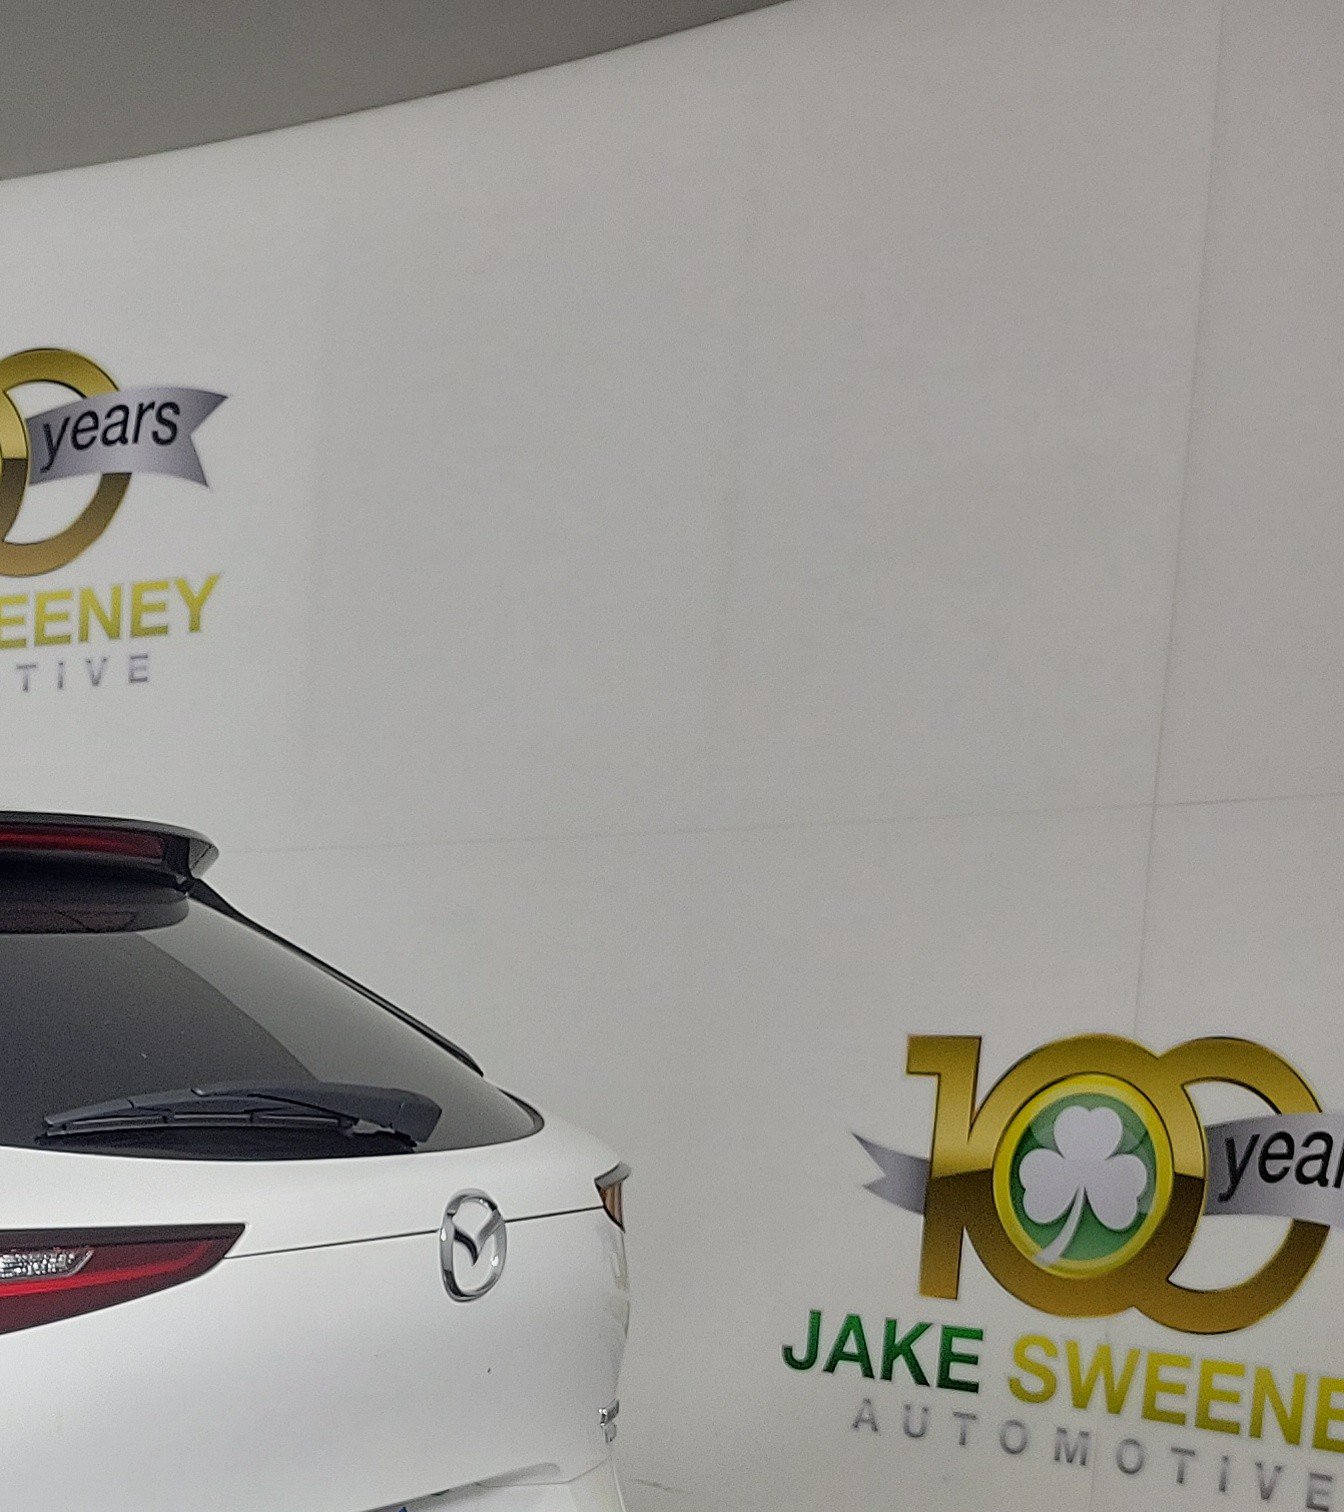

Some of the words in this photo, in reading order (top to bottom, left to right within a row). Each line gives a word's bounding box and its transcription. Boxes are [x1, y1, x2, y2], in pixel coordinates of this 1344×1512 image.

[40, 398, 181, 473] years
[906, 1033, 1331, 1335] 100
[781, 1309, 984, 1394] JAKE
[851, 1398, 1334, 1512] AUTOMOTIVE
